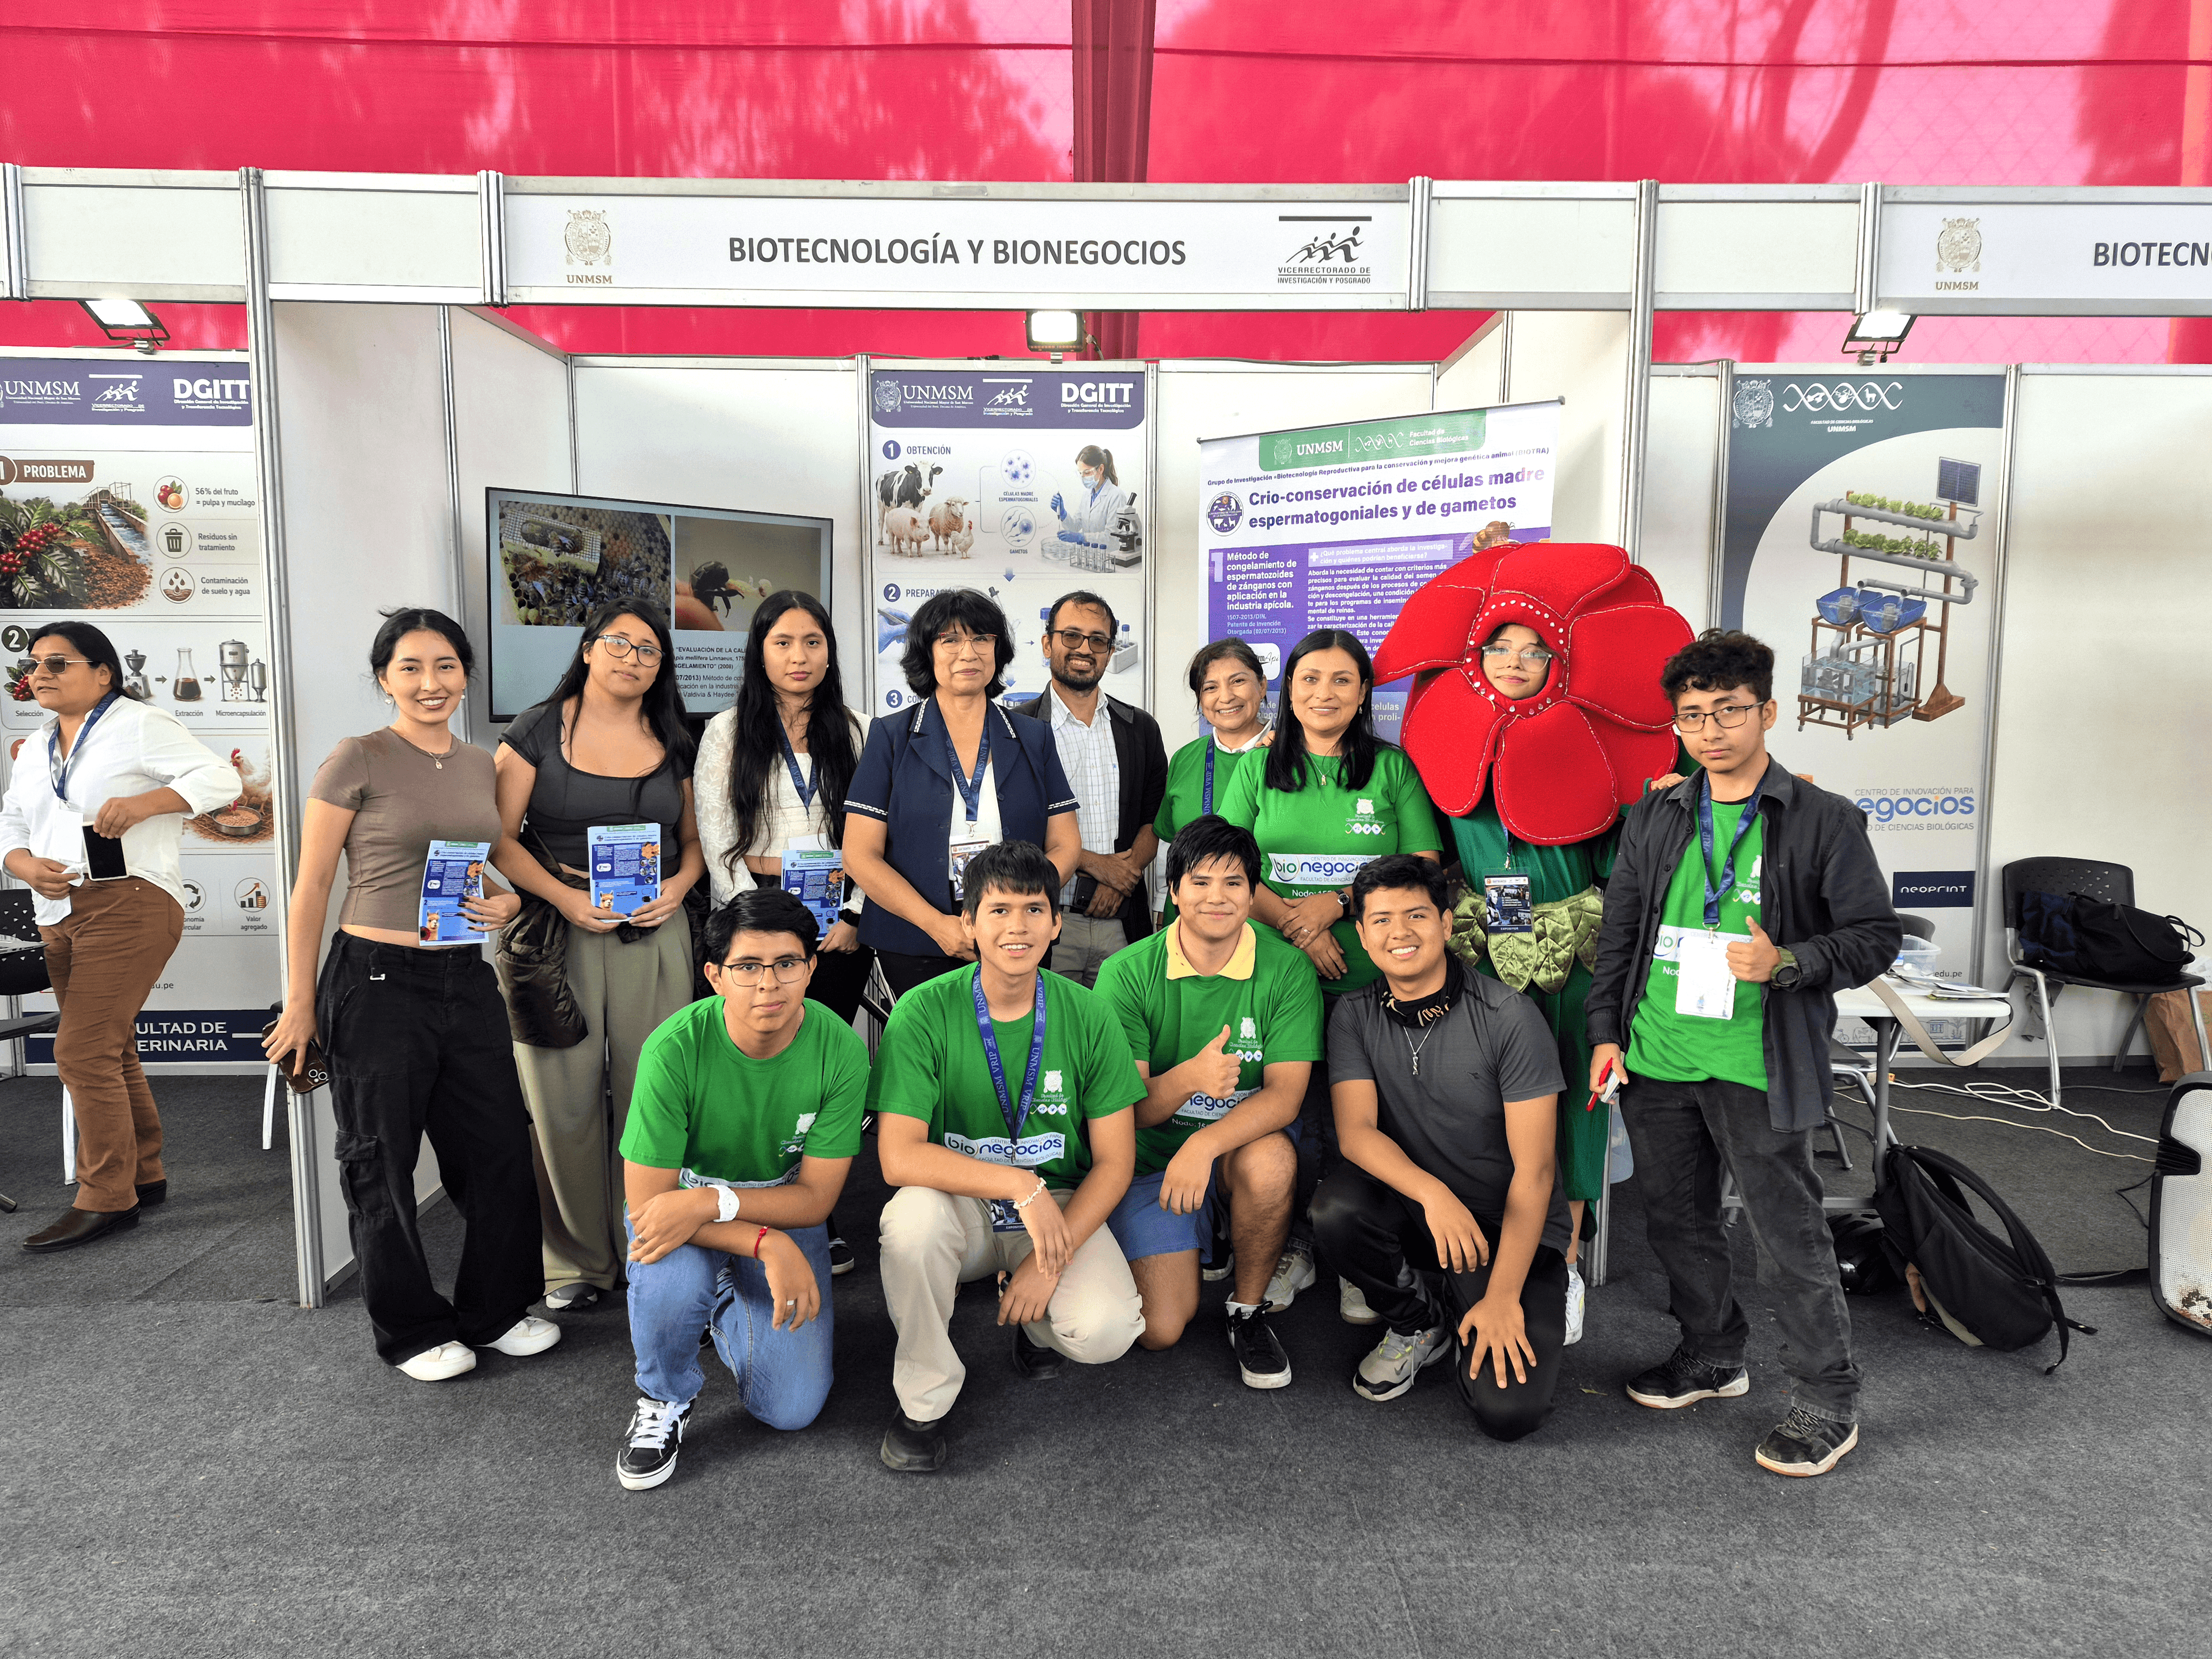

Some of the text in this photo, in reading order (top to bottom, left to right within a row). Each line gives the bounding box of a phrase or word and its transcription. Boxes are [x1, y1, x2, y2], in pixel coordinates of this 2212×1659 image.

[729, 233, 1185, 265] BIOTECNOLOGÍA Y BIONEGOCIOS
[2094, 242, 2212, 267] BIOTECN
[566, 275, 613, 284] UNMSM
[1936, 282, 1979, 290] UNMSM
[3, 380, 81, 396] UNMSM
[173, 378, 250, 399] DGITT
[903, 385, 974, 400] UNMSM
[1062, 382, 1134, 403] DGITT
[1409, 429, 1435, 438] Facultad
[1409, 434, 1469, 446] Ciencias Biológicas
[888, 444, 951, 457] 1 OBTENCIÓN
[1297, 440, 1343, 456] UNMSM
[23, 464, 87, 478] PROBLEMA
[1234, 475, 1272, 483] Investigación
[1274, 470, 1318, 480] «Biotecnología
[1319, 467, 1360, 476] Reproductiva
[1361, 464, 1375, 472] para
[1384, 459, 1428, 469] conservación
[1434, 456, 1459, 465] mejora
[1460, 453, 1490, 464] genética
[1491, 450, 1514, 459] animal
[1515, 448, 1550, 457] (BIOTRA)
[1249, 467, 1545, 506] Crio-conservación de células madre
[202, 498, 220, 508] pulpa
[227, 498, 255, 507] mucílago
[1249, 504, 1399, 530] espermatogoniales
[1402, 505, 1412, 519] y
[1416, 501, 1437, 516] de
[1440, 496, 1517, 517] gametos
[198, 533, 226, 541] Residuos
[1227, 550, 1269, 561] Método de
[1211, 552, 1224, 582] 1
[1227, 559, 1297, 572] congelamiento de
[200, 577, 248, 585] Contaminación
[1227, 569, 1294, 582] espermatozoides
[210, 587, 228, 595] suelo
[888, 586, 896, 600] 2
[1227, 582, 1237, 590] de
[1238, 581, 1276, 592] zánganos
[1227, 591, 1267, 602] aplicación
[1280, 590, 1287, 599] la
[1227, 600, 1294, 611] industria apícola.
[8, 630, 21, 649] 2
[890, 692, 899, 706] 3
[16, 709, 44, 718] Selección
[175, 709, 203, 718] Extracción
[215, 709, 266, 718] Microencapsulación
[1378, 713, 1401, 722] proli-
[976, 747, 987, 775] UNMSM
[954, 768, 969, 798] UNMSM
[1903, 786, 1952, 795] INNOVACIÓN
[1855, 795, 1975, 823] egocios
[1888, 823, 1925, 831] CIENCIAS
[1927, 821, 1974, 831] BIOLÓGICAS
[1274, 858, 1368, 877] bio negoci
[240, 923, 267, 931] agregado
[1934, 970, 1963, 979] edu.pe
[136, 1021, 226, 1035] ULTAD DE
[137, 1039, 228, 1052] ERINARIA
[988, 1051, 1009, 1113] UNMSM VRIP
[1020, 1047, 1040, 1111] UNMSM VRIP
[948, 1136, 1062, 1159] bio negocios
